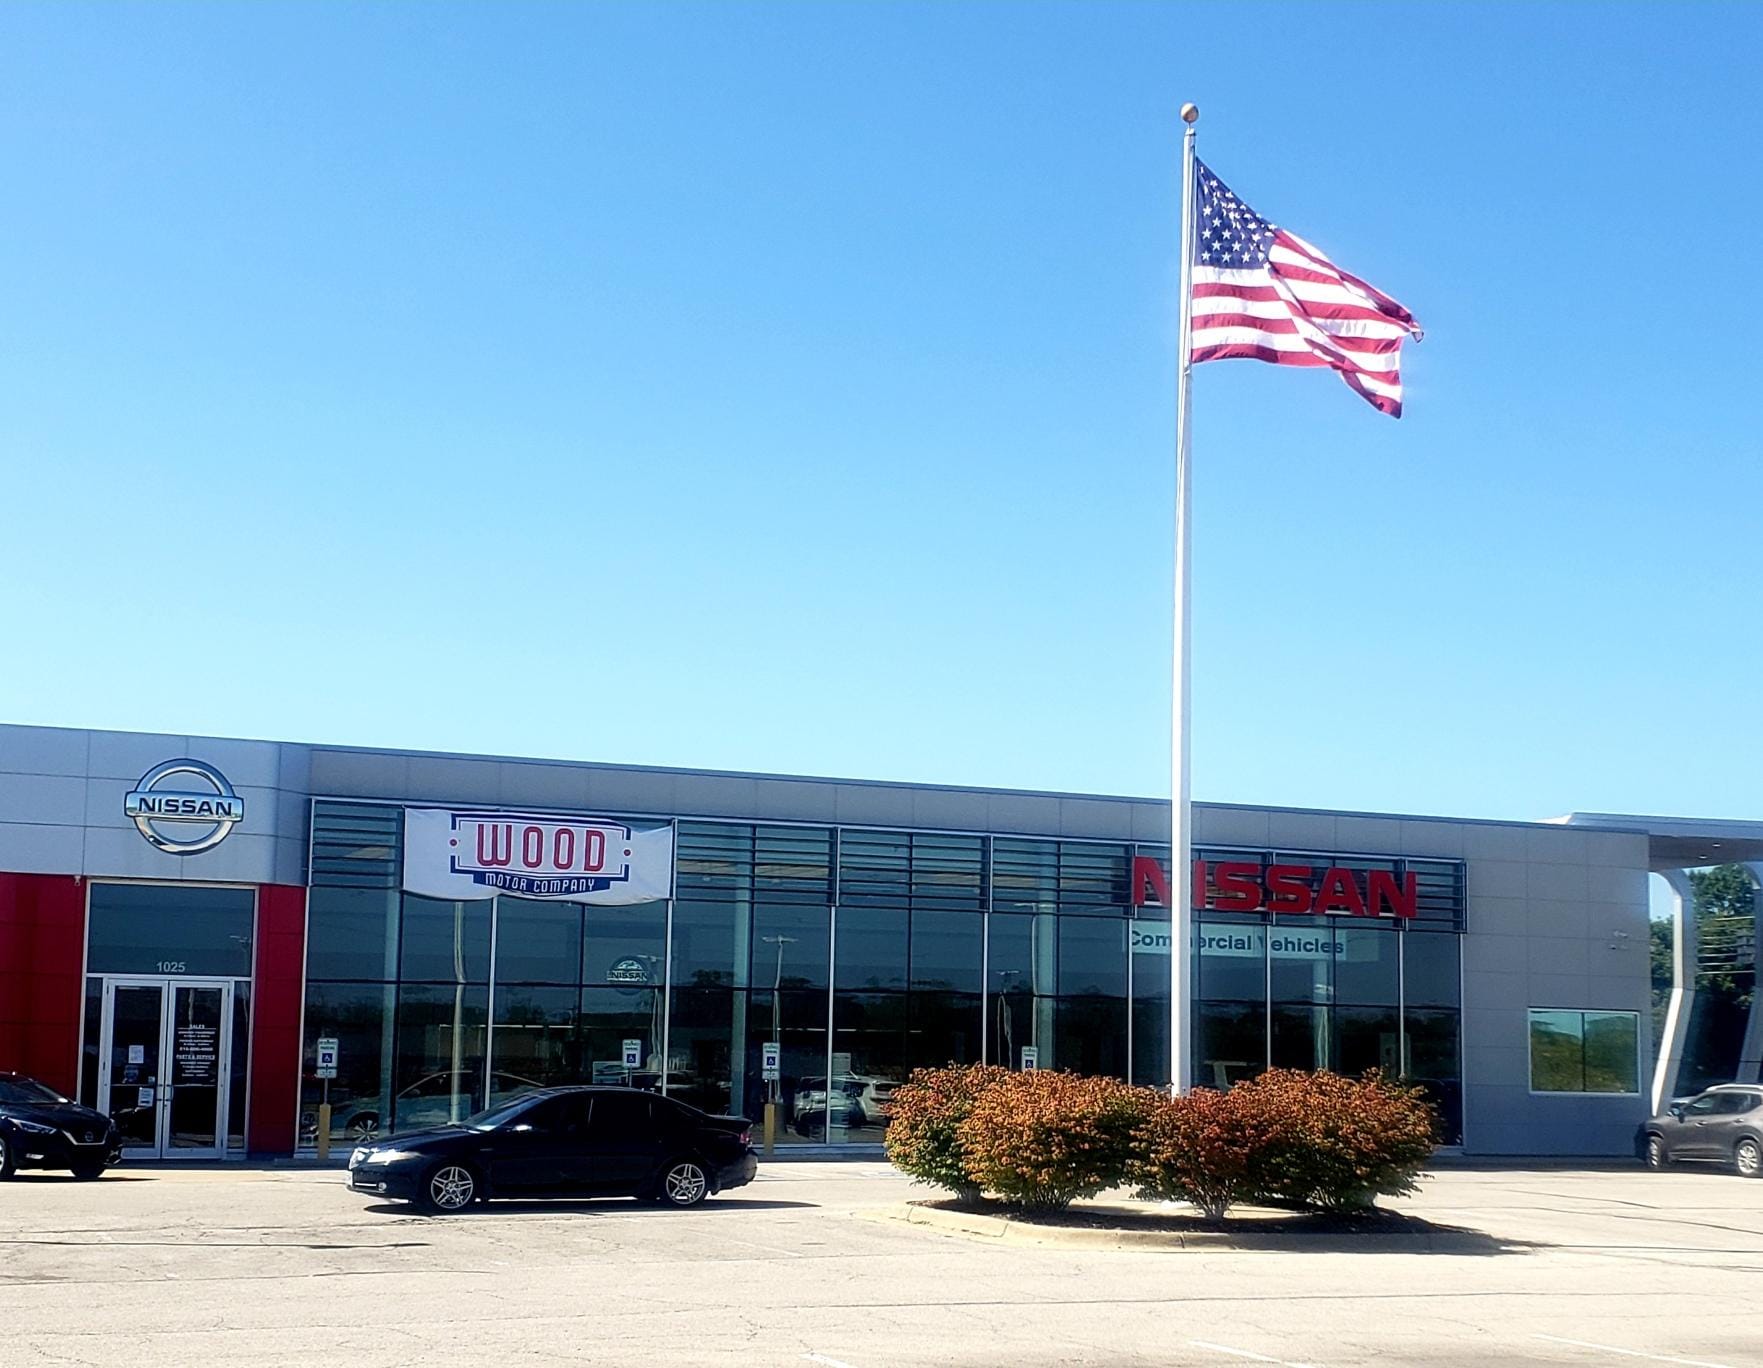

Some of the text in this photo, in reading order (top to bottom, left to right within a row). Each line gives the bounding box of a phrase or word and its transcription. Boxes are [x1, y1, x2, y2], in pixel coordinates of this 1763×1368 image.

[138, 797, 232, 816] NISSAN
[477, 824, 605, 872] WOOD
[485, 873, 595, 893] MOTOR COMPANY
[1132, 855, 1417, 918] NISSAN
[156, 961, 186, 973] 1025
[611, 972, 648, 981] NISSAN
